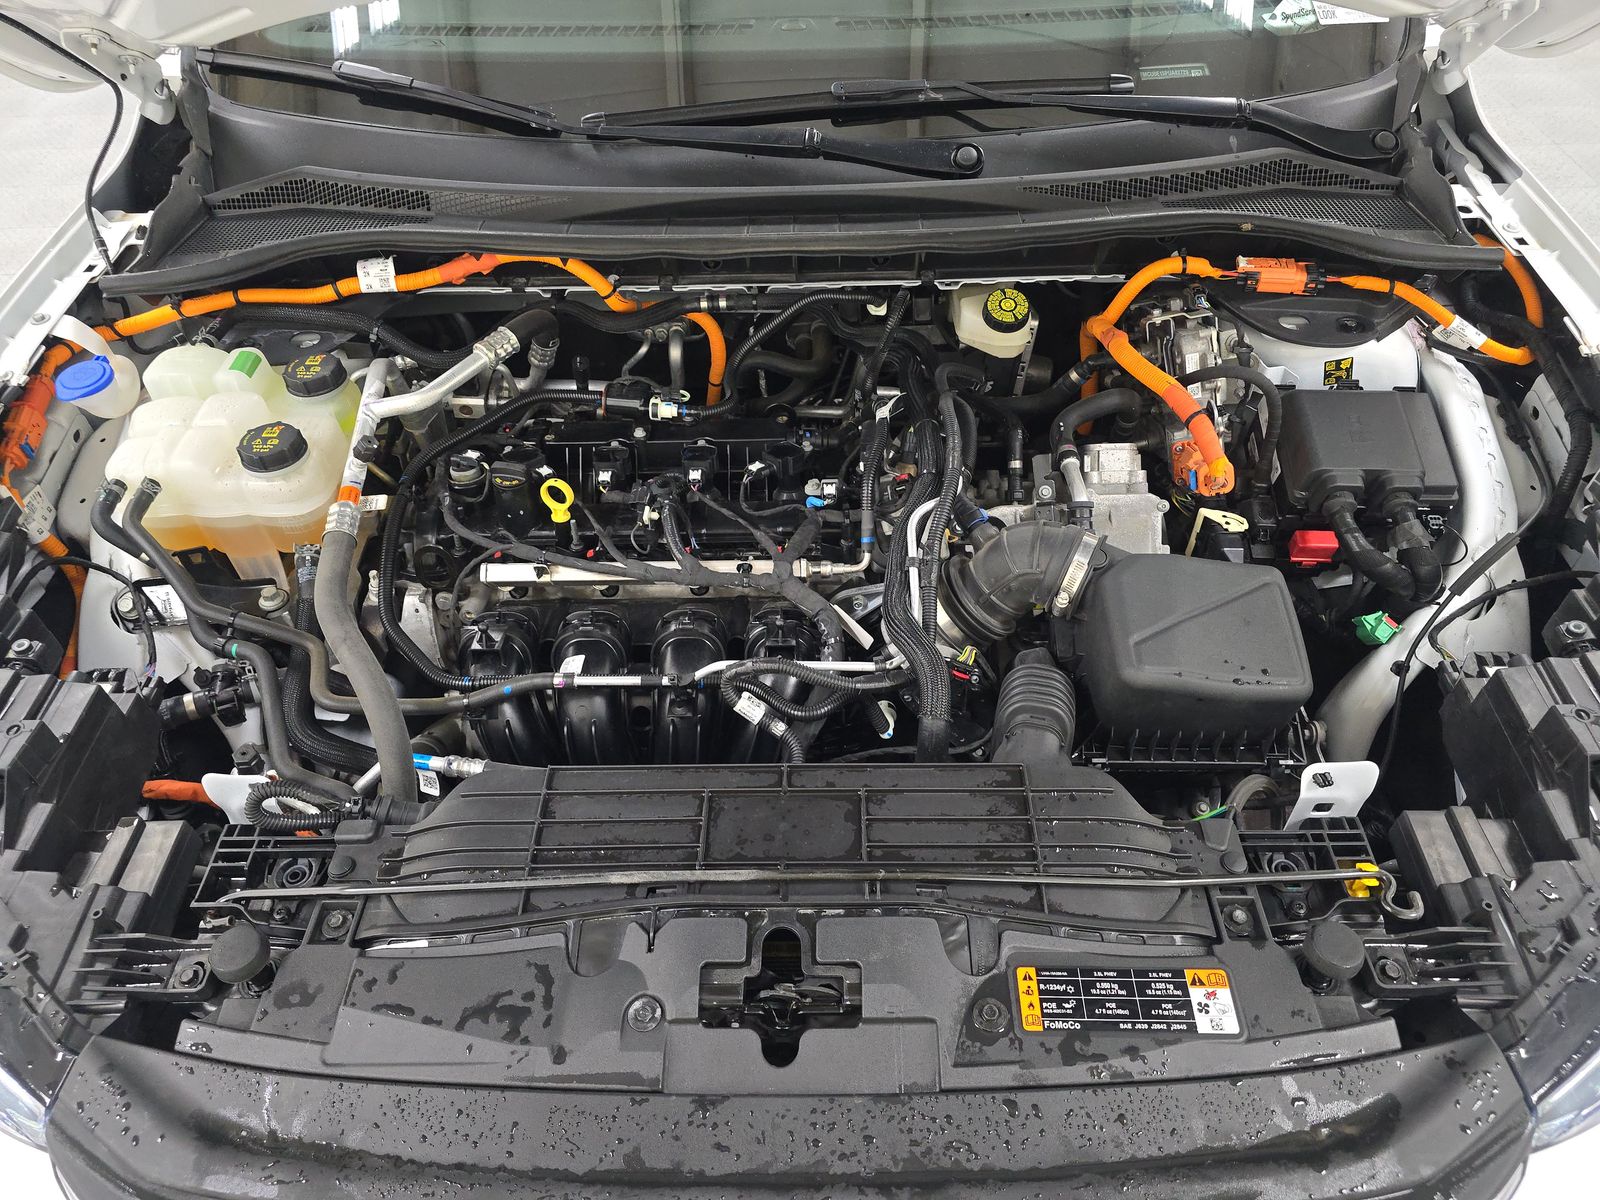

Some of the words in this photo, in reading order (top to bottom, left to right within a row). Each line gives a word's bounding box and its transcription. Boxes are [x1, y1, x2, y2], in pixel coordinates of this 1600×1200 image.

[1039, 983, 1066, 992] R-1234yf
[1111, 982, 1119, 990] kg
[1166, 982, 1174, 990] kg
[1044, 1020, 1081, 1030] FoMoCo
